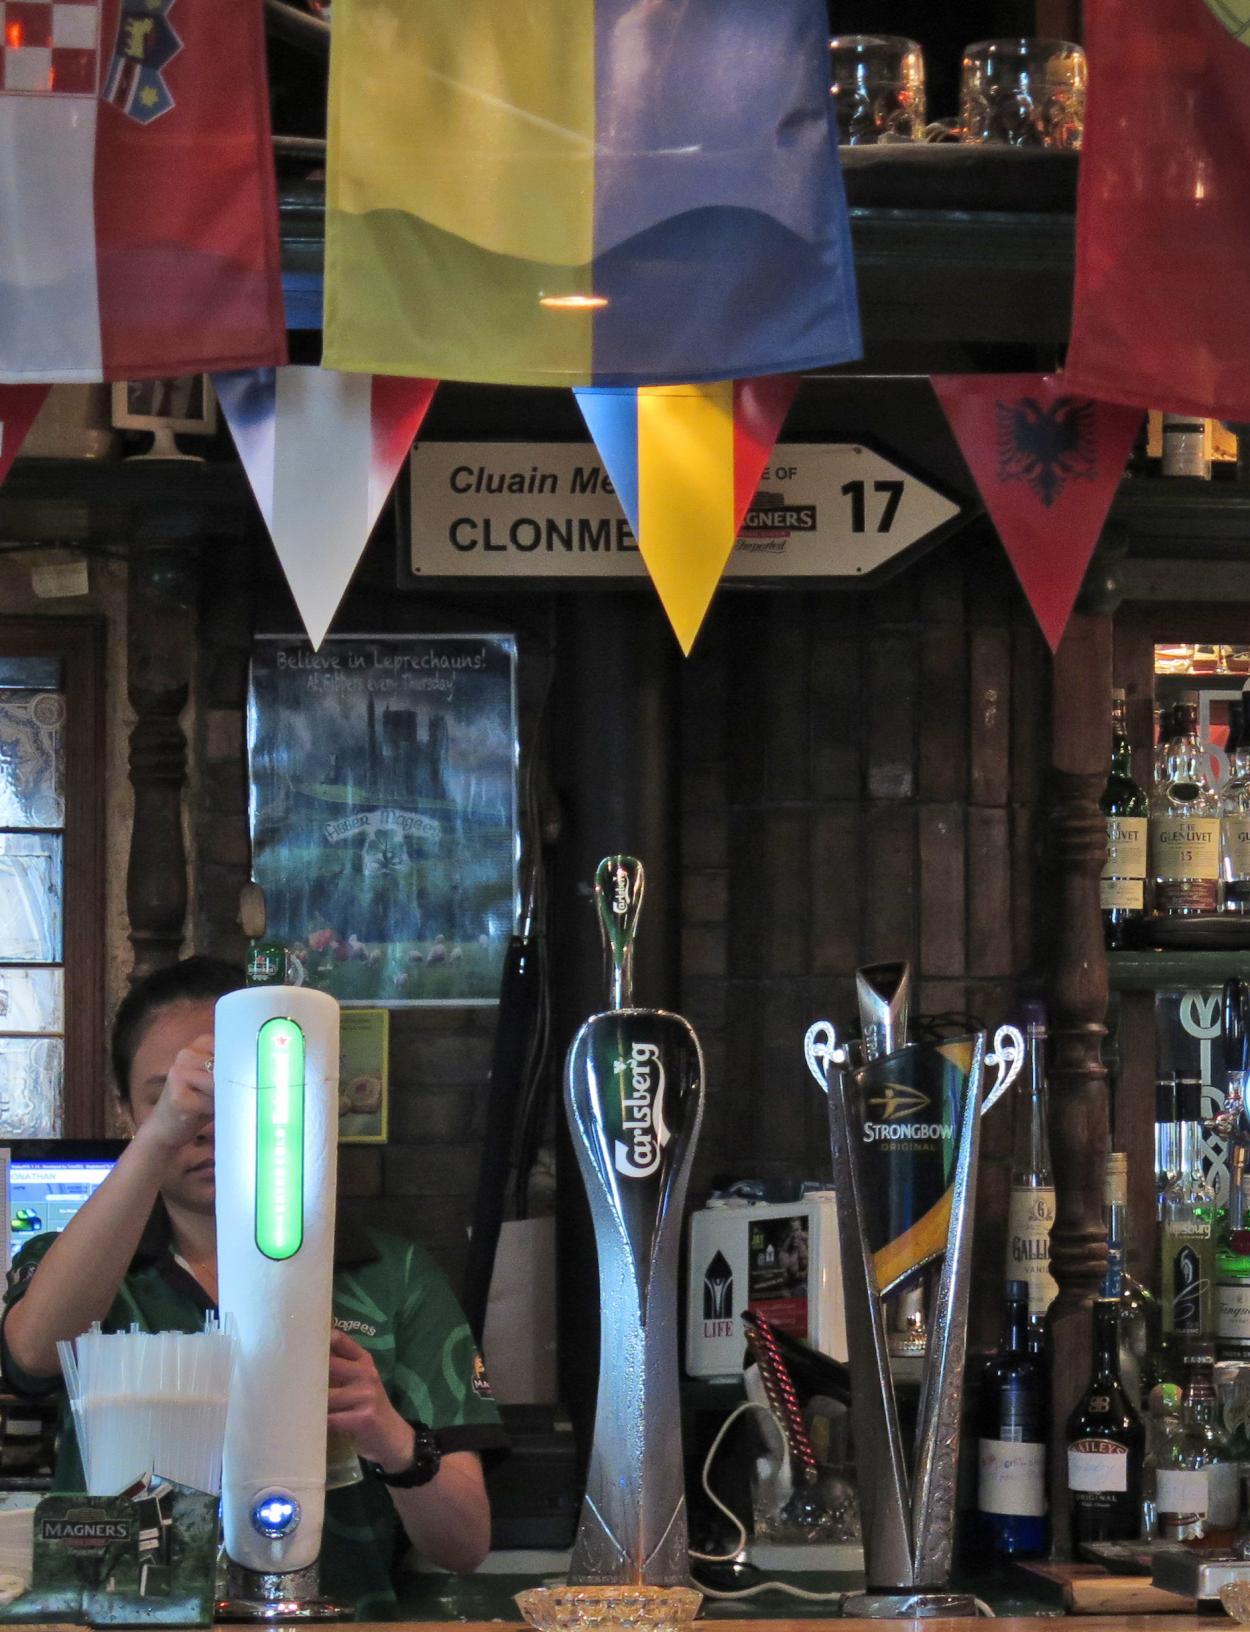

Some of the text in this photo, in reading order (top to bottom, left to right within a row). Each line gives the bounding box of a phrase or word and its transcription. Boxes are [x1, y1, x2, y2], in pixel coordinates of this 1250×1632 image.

[449, 466, 617, 495] Cluain Me
[775, 467, 798, 481] OF
[840, 480, 904, 533] 17
[744, 510, 813, 528] GNERS
[448, 517, 639, 552] CLONME
[277, 648, 487, 670] Believe in Leprechauns!
[611, 868, 630, 915] Carlsberg
[614, 1041, 672, 1179] Carlsberg
[863, 1122, 953, 1143] STRONGBOW
[880, 1143, 937, 1152] ORIGINAL
[11, 1172, 57, 1181] ONATHAN
[1012, 1236, 1050, 1262] GALLI
[703, 1321, 733, 1339] LIFE
[44, 1522, 128, 1538] MAGNERS
